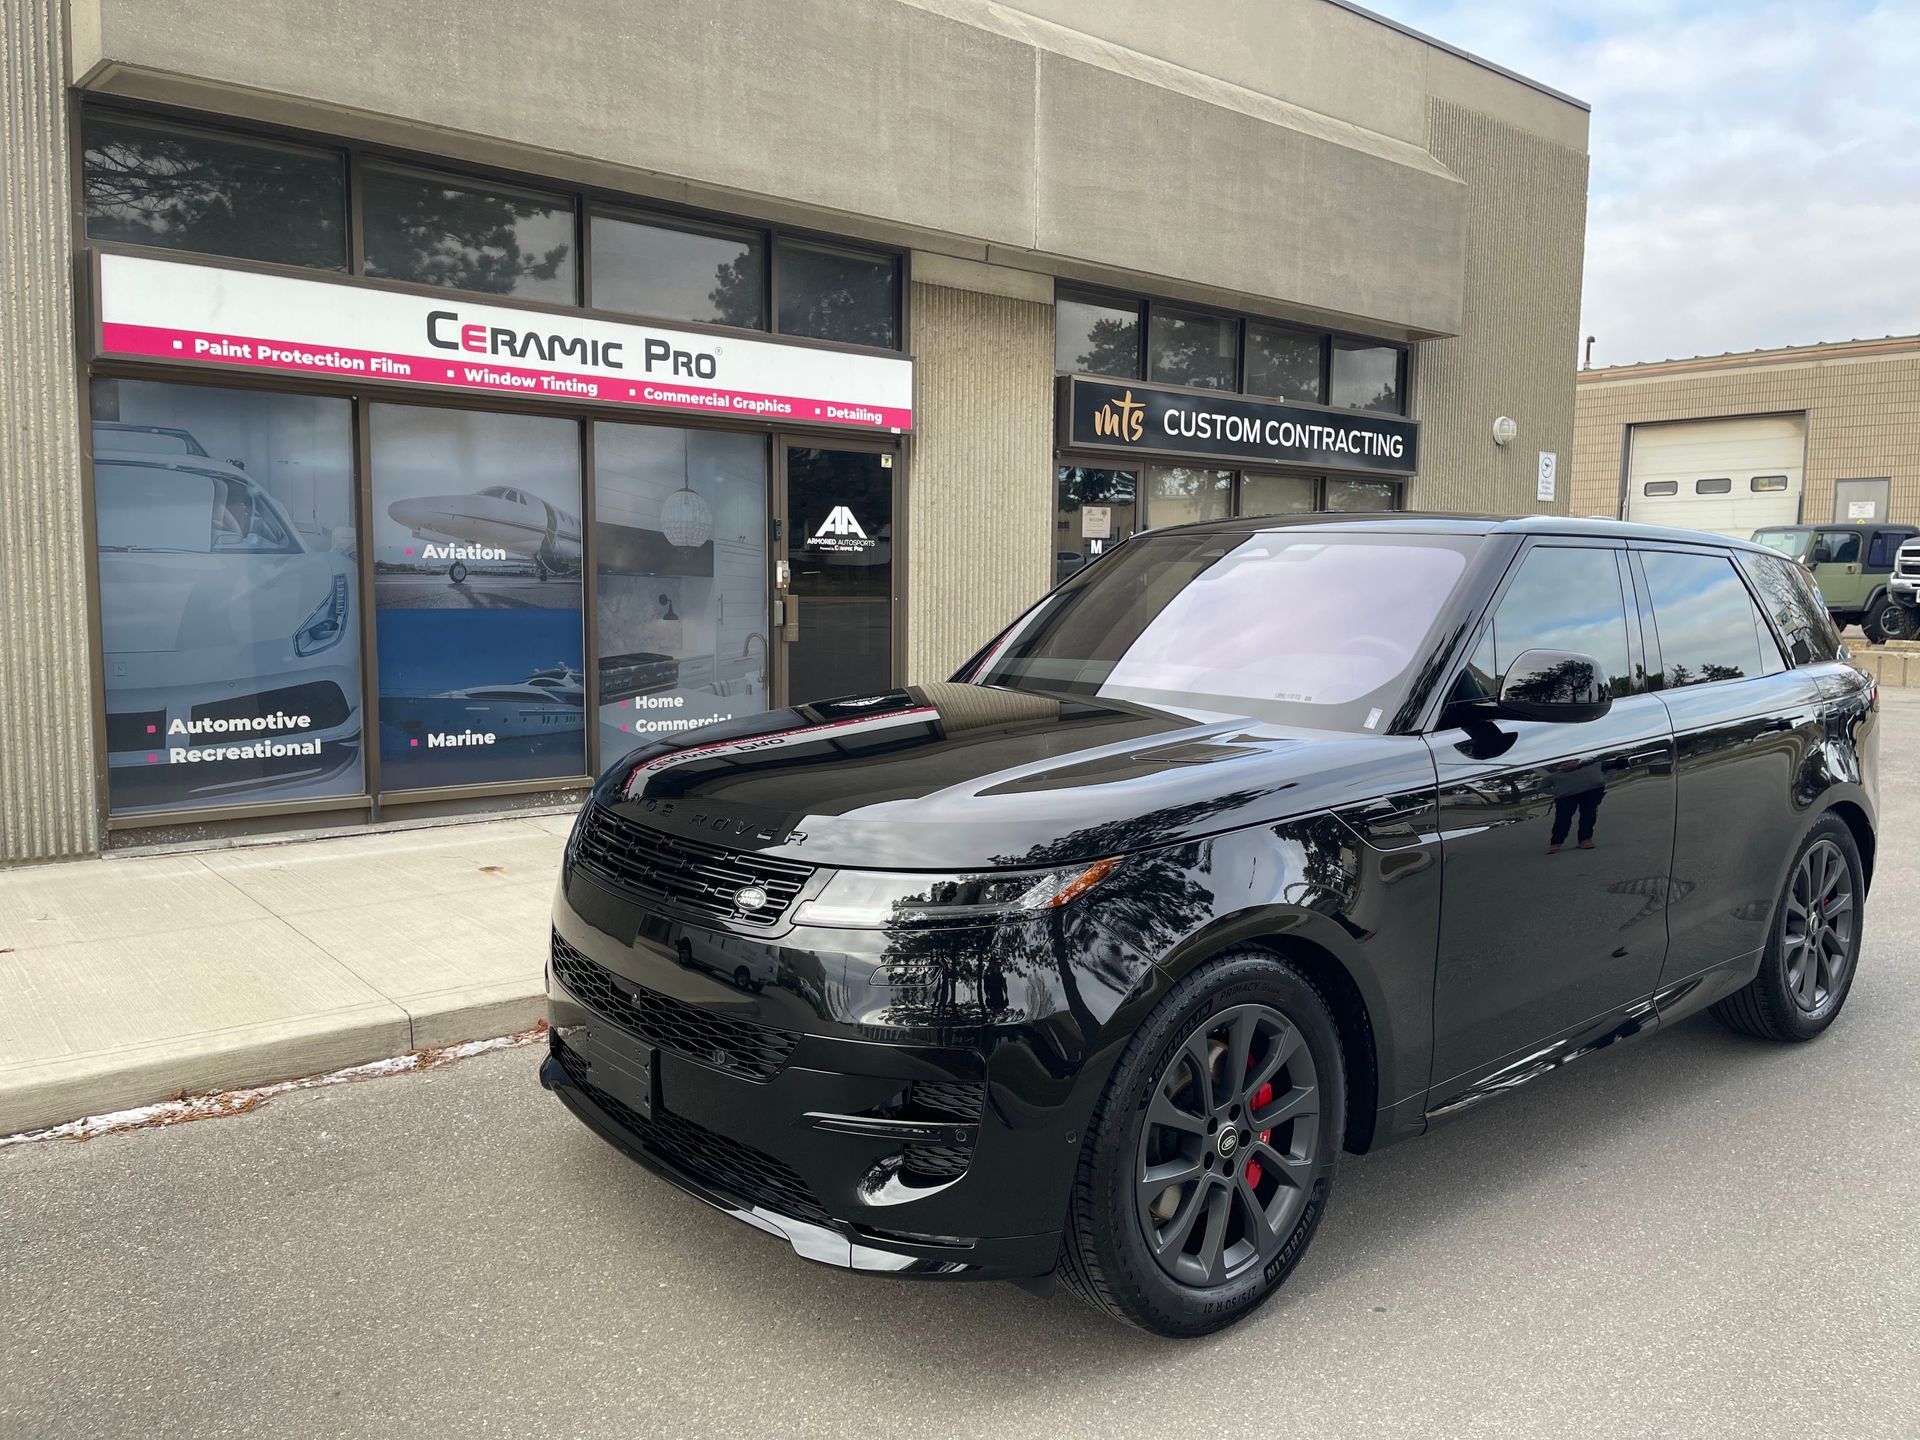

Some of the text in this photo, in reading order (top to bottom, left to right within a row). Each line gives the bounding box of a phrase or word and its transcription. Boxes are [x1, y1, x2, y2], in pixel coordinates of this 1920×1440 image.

[194, 338, 411, 376] Paint Protection Film
[464, 368, 599, 397] Window Tinting
[644, 387, 792, 414] Commercial Graphics
[826, 406, 883, 424] Detailing
[1094, 390, 1146, 442] mts
[1163, 408, 1404, 458] CUSTOM CONTRACTING
[422, 543, 507, 561] Aviation
[807, 537, 876, 547] ARMORED AUTOSPORTS
[635, 696, 684, 710] Home
[167, 711, 312, 735] Automotive
[635, 713, 732, 733] Commerci
[169, 738, 322, 764] Recreational
[427, 729, 497, 748] Marine
[690, 814, 809, 846] ROVER
[1154, 1002, 1210, 1078] MICHELIN
[1266, 1205, 1317, 1280] MICHELIN
